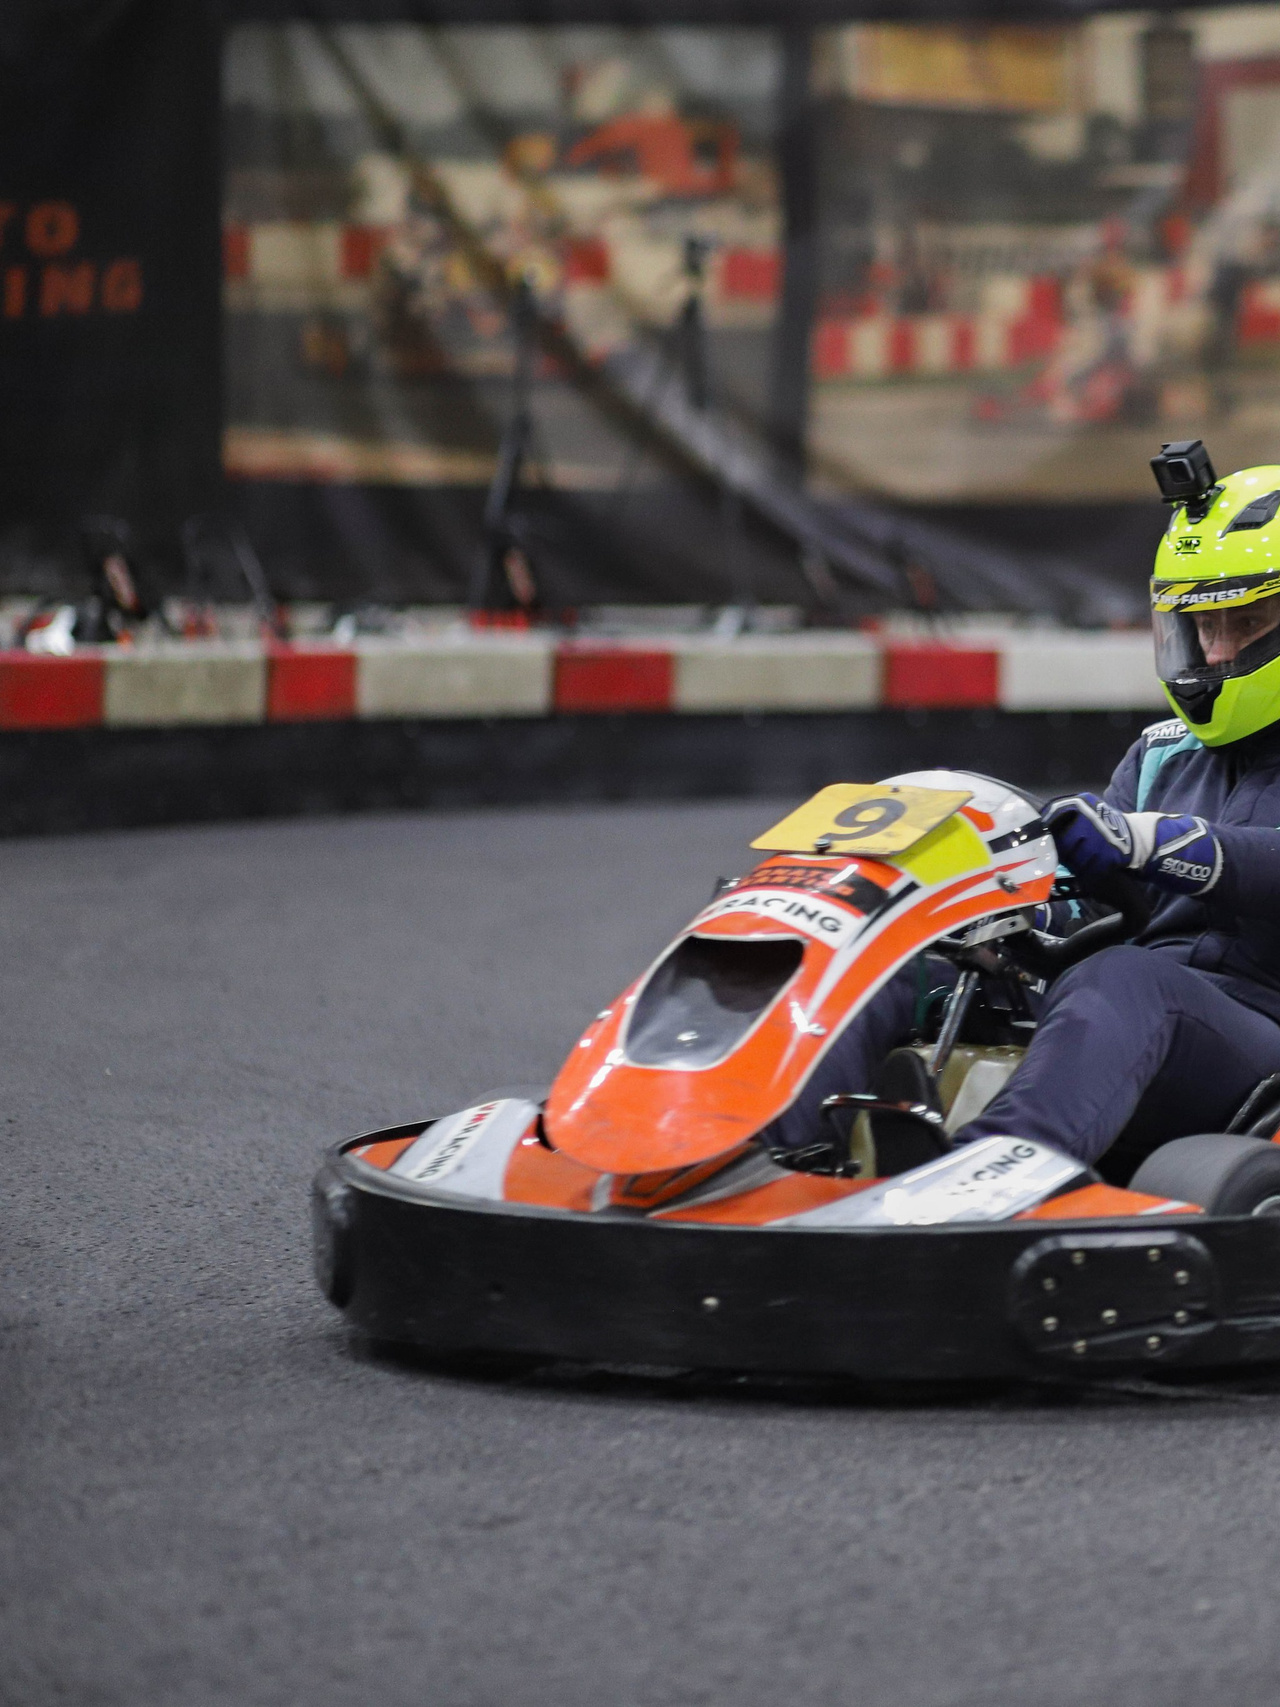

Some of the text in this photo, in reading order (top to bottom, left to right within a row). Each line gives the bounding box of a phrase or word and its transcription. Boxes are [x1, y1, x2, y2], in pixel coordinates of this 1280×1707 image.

[1180, 588, 1247, 605] FASTEST
[819, 797, 907, 841] 9
[1160, 857, 1212, 879] sparco
